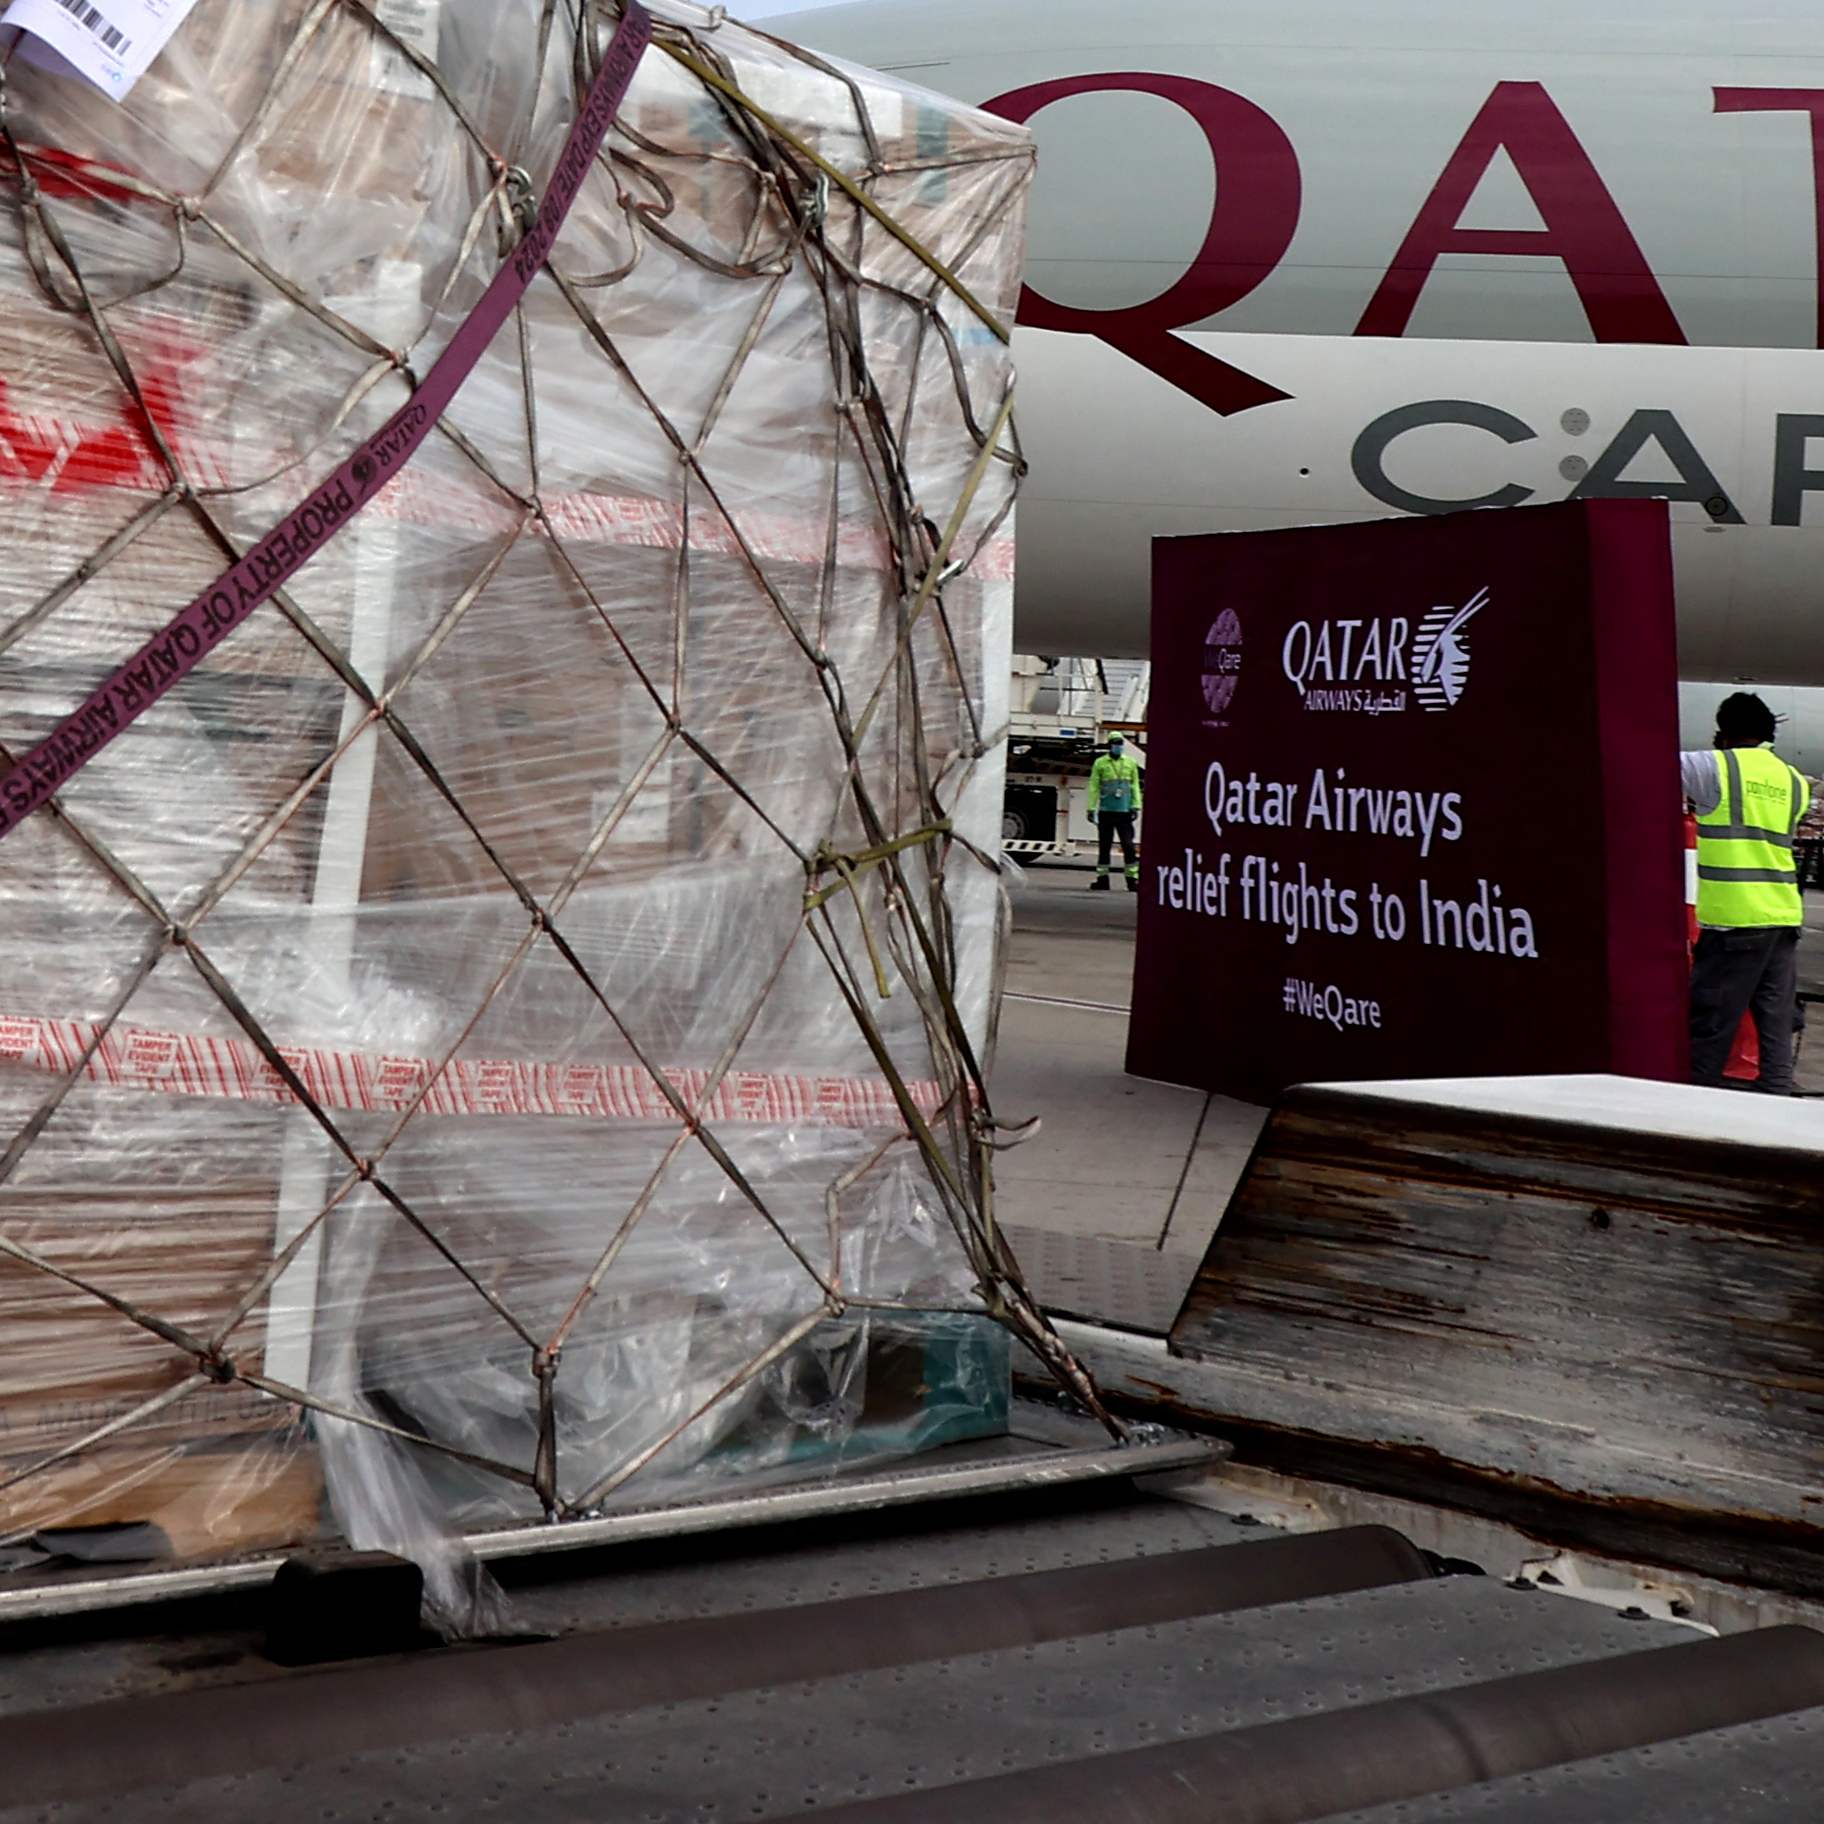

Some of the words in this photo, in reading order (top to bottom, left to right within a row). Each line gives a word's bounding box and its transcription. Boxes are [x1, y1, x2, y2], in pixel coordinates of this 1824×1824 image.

[369, 403, 427, 468] QATAR
[231, 479, 356, 611] PROPERTY
[199, 591, 236, 642] OF
[111, 624, 202, 711] QATAR
[1282, 617, 1408, 696] QATAR
[1304, 689, 1363, 712] AIRWAYS
[2, 693, 119, 813] AIRWAYS
[1204, 761, 1297, 838] Qatar
[1304, 766, 1464, 856] Airways
[1157, 848, 1231, 915] relief
[1241, 856, 1360, 945] flights
[1371, 883, 1406, 941] to
[1421, 879, 1539, 959] India
[1283, 977, 1382, 1031] #WeQare
[128, 1050, 171, 1062] EVIDENT
[132, 1038, 172, 1051] TAMPER
